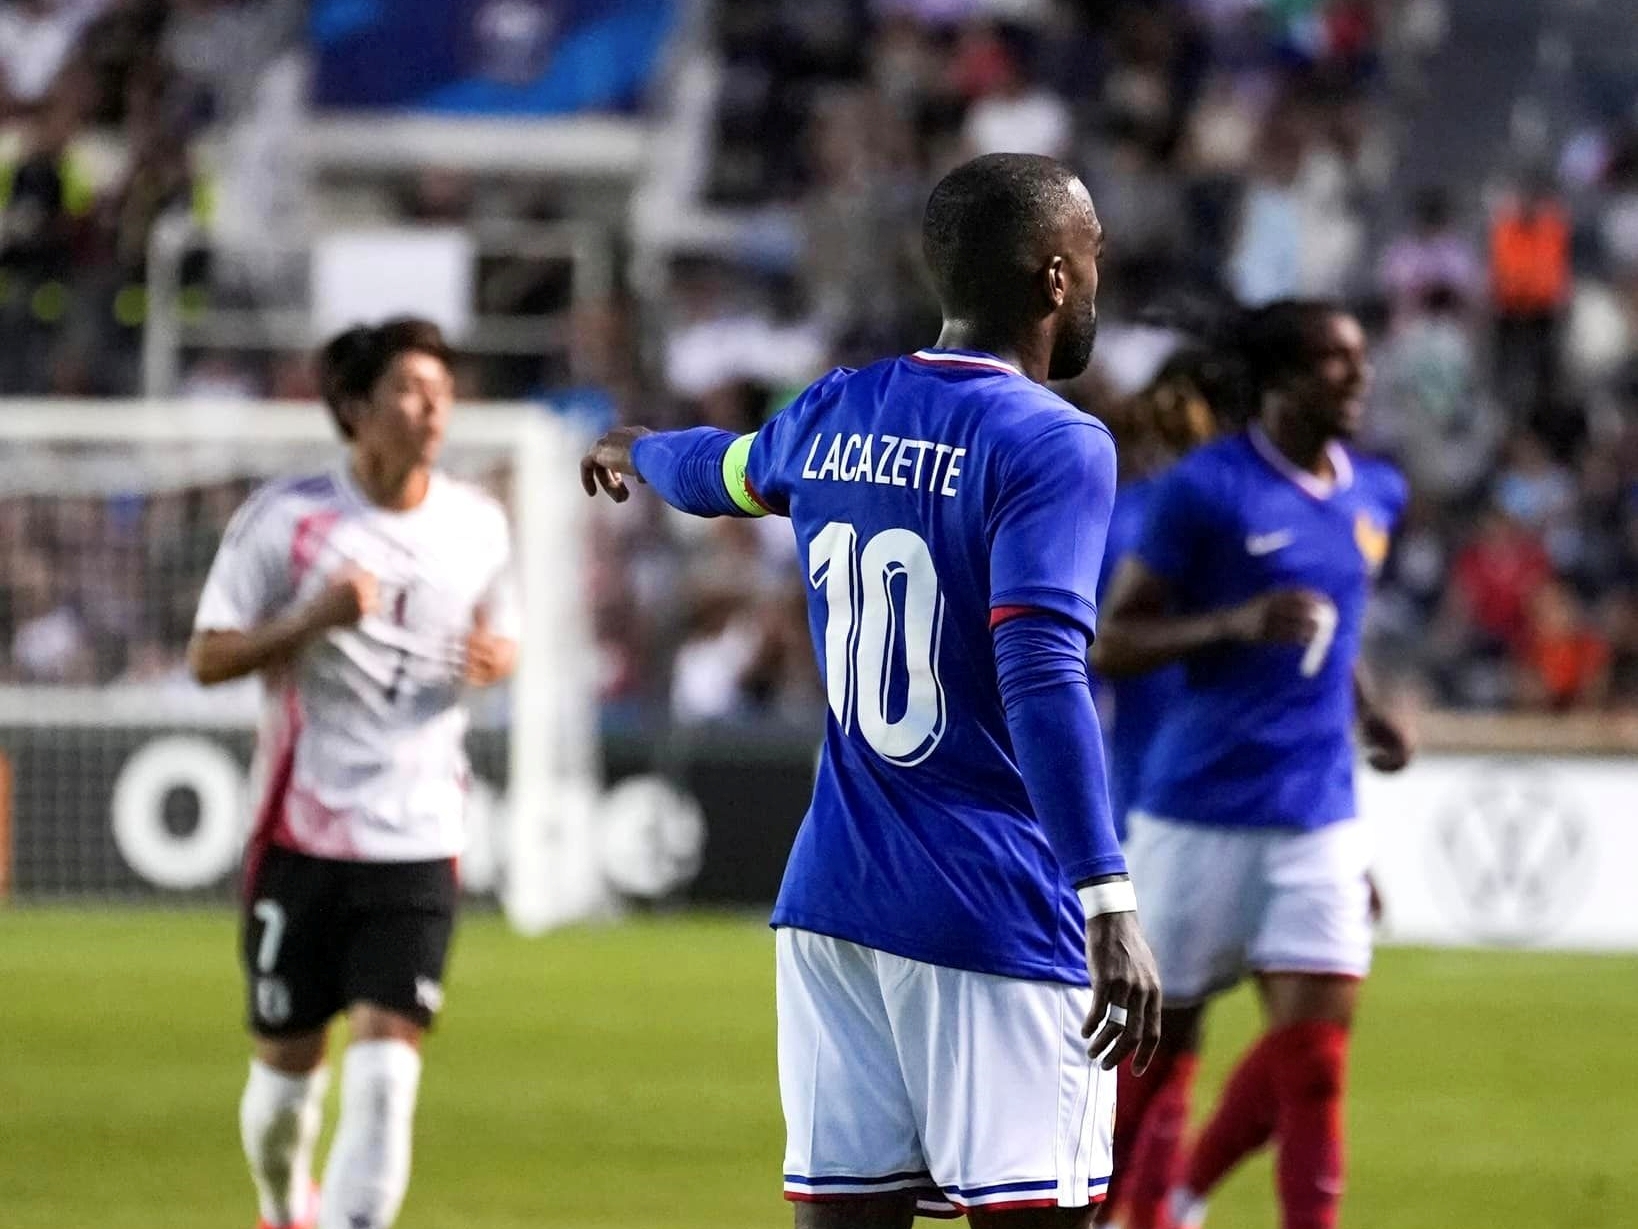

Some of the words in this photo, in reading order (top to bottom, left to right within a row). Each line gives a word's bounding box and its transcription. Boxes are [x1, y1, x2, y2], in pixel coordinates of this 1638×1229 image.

[801, 432, 967, 497] LACAZETTE
[808, 521, 947, 767] 10
[254, 900, 285, 972] 7
